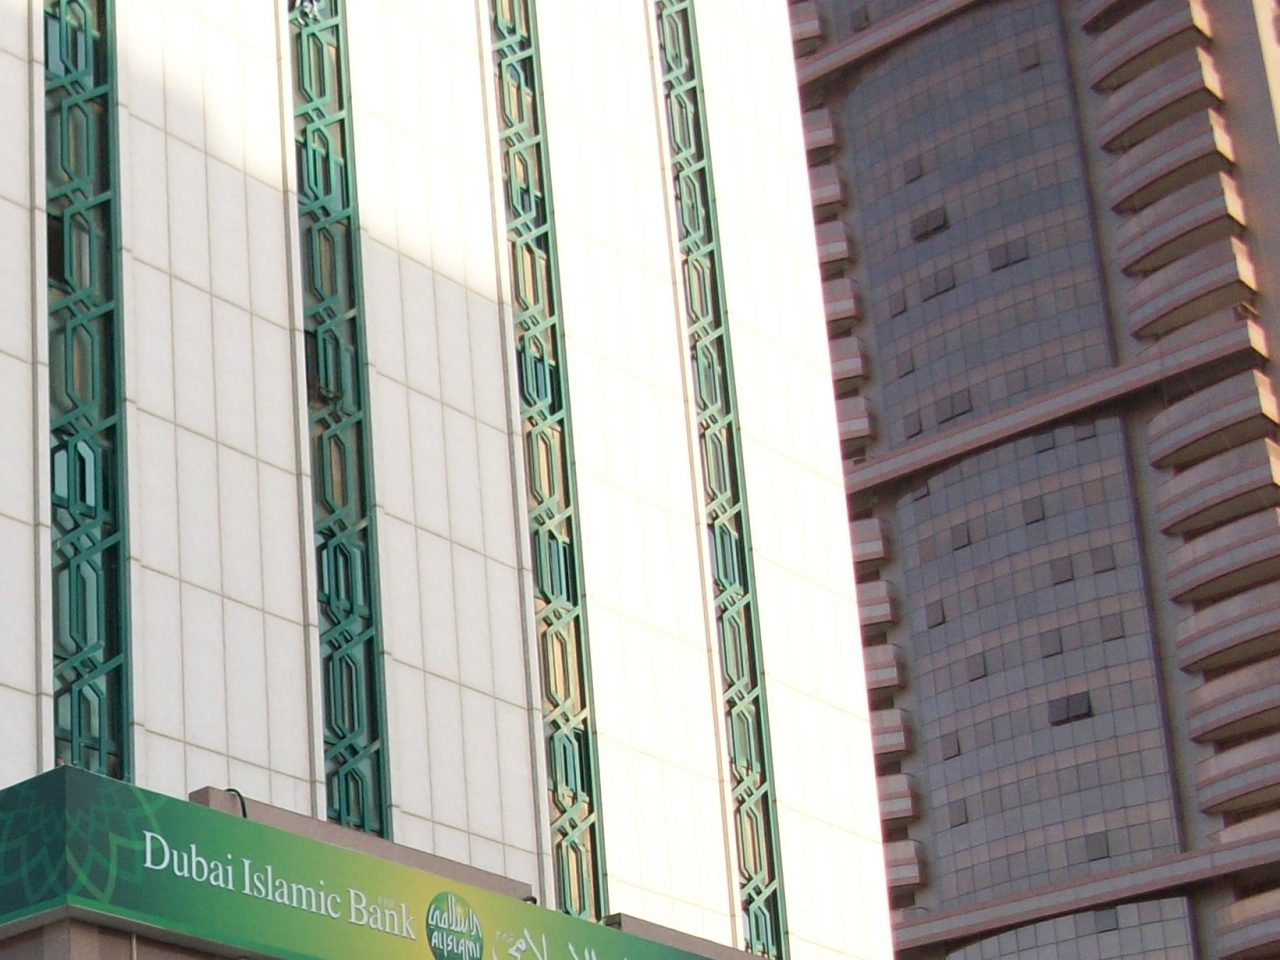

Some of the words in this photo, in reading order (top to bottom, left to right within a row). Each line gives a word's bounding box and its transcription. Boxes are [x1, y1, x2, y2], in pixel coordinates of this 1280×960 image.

[142, 830, 235, 891] Dubai
[240, 857, 342, 919] Islamic
[347, 887, 417, 940] Bank
